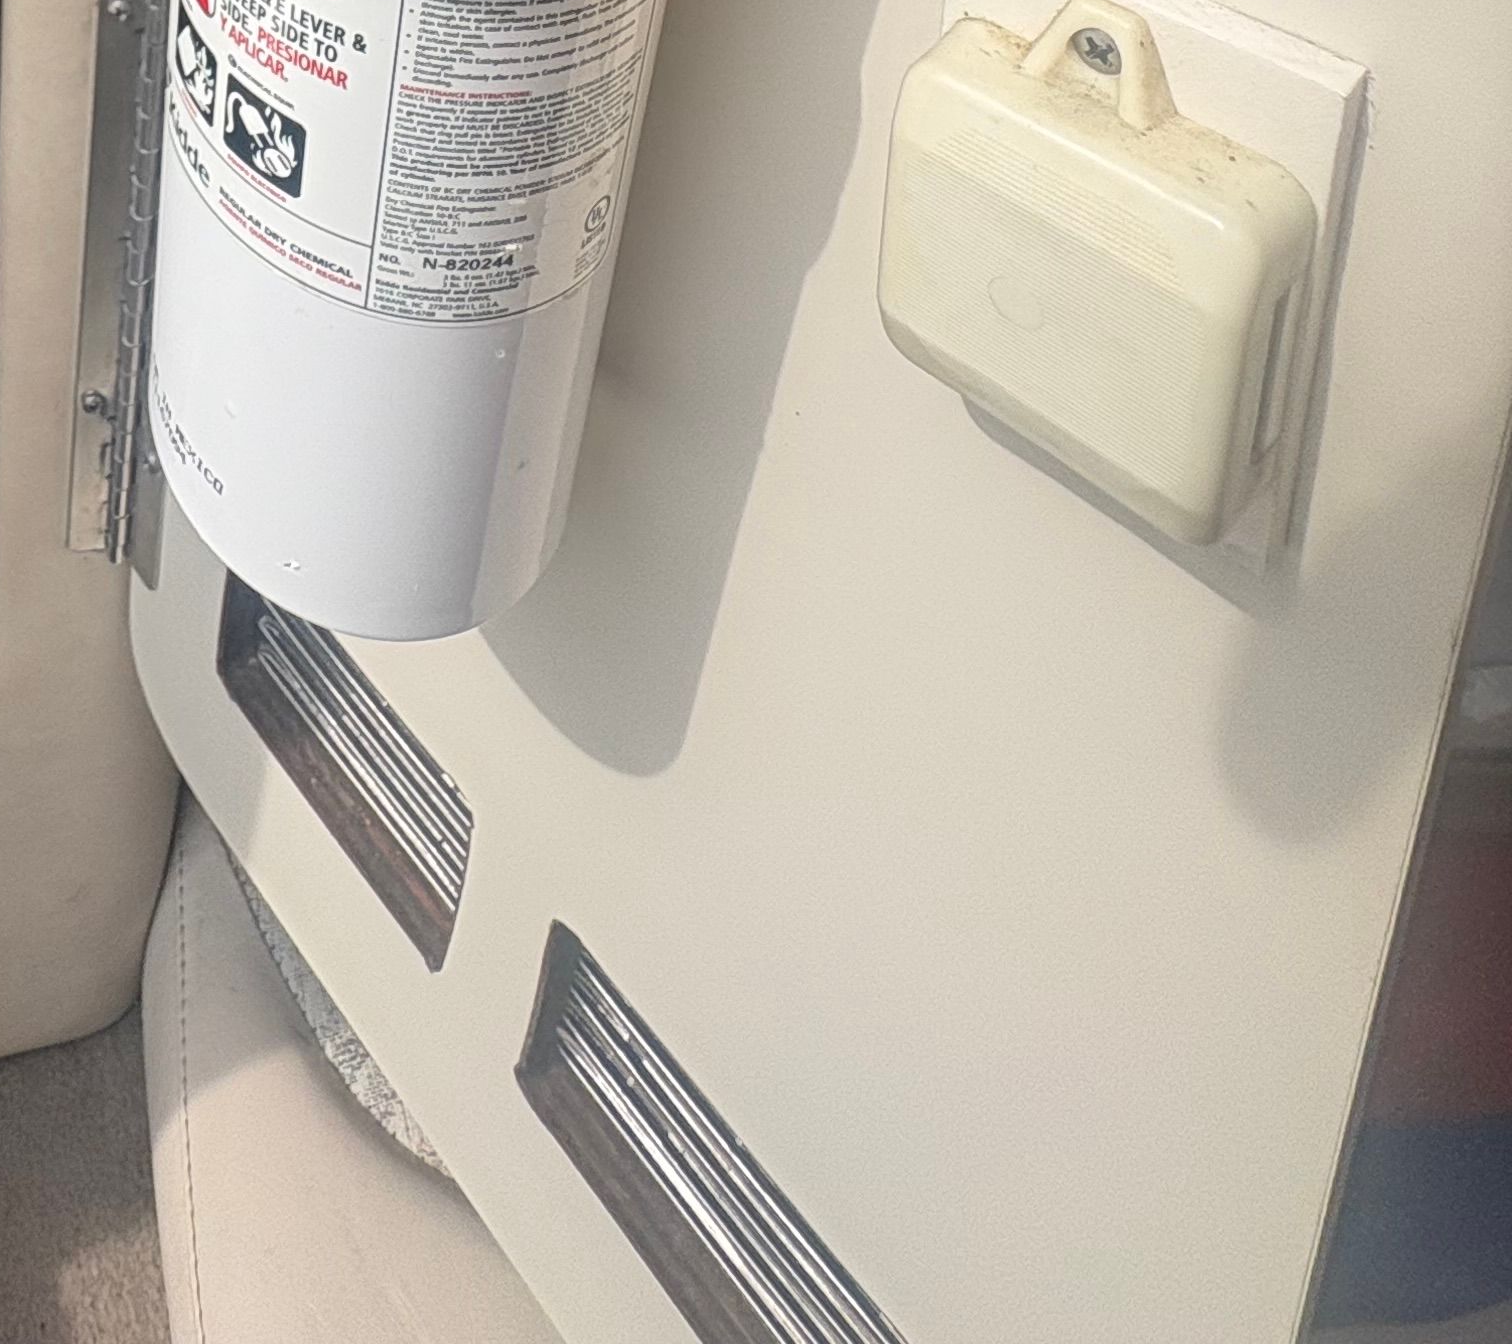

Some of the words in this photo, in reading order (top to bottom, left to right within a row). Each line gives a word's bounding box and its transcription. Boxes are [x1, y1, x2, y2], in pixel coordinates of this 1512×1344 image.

[220, 14, 227, 31] Y
[228, 27, 288, 82] APLICAR.
[271, 15, 309, 51] SIDE
[316, 37, 338, 63] TO
[291, 3, 345, 46] LEVER
[352, 34, 367, 54] &
[257, 27, 348, 90] PRESIONAR
[400, 84, 465, 99] MAINTENANCE
[219, 186, 262, 230] REGULAR
[264, 225, 287, 246] DRY
[290, 243, 354, 279] CHEMICAL
[315, 267, 362, 292] REGULAR
[422, 254, 514, 271] N-820244
